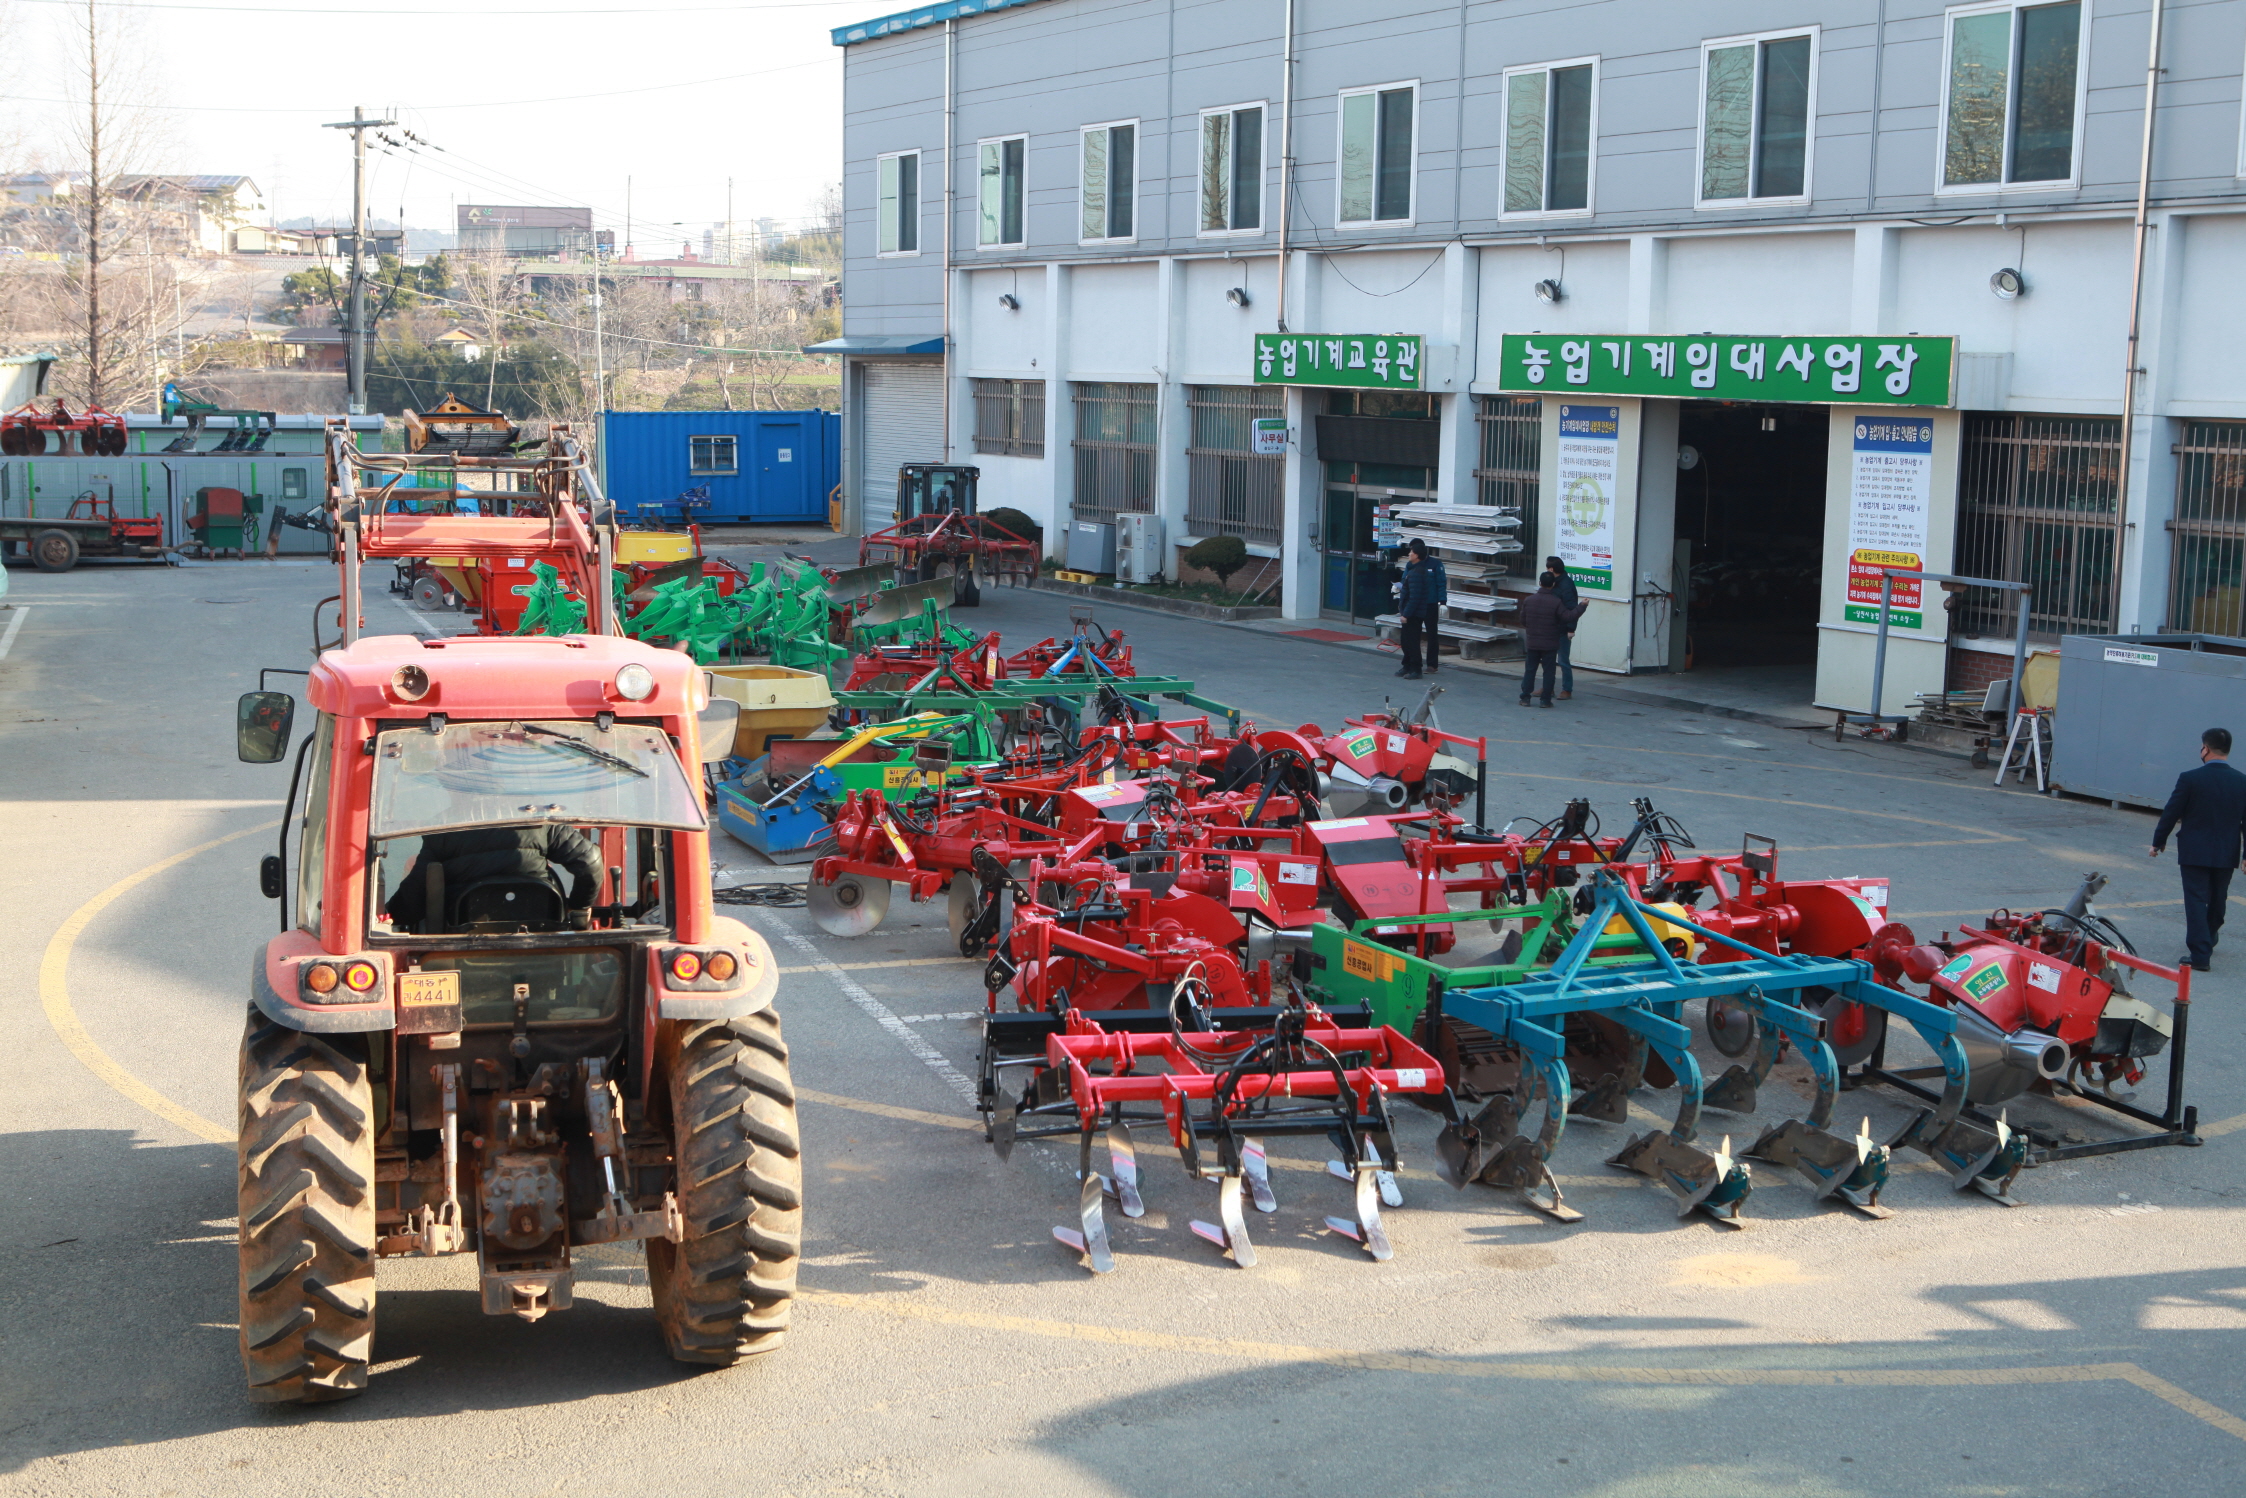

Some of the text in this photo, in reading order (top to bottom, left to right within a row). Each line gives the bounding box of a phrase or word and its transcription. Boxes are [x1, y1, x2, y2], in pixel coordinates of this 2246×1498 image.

[1258, 339, 1417, 382] 농업기계교육관
[1522, 340, 1920, 395] 농업기계임대사업장
[1260, 433, 1284, 444] 사무실
[1869, 425, 1885, 441] 농업기계
[1885, 457, 1897, 465] 출고시
[1900, 458, 1917, 466] 당부사항
[1898, 504, 1915, 512] 당부사항
[1864, 552, 1908, 564] 농업기계 관련 주의사항
[1851, 578, 1859, 586] 개인
[1861, 579, 1879, 588] 농업기계
[1894, 582, 1908, 591] 수리는
[1347, 956, 1372, 973] 신흥공업사
